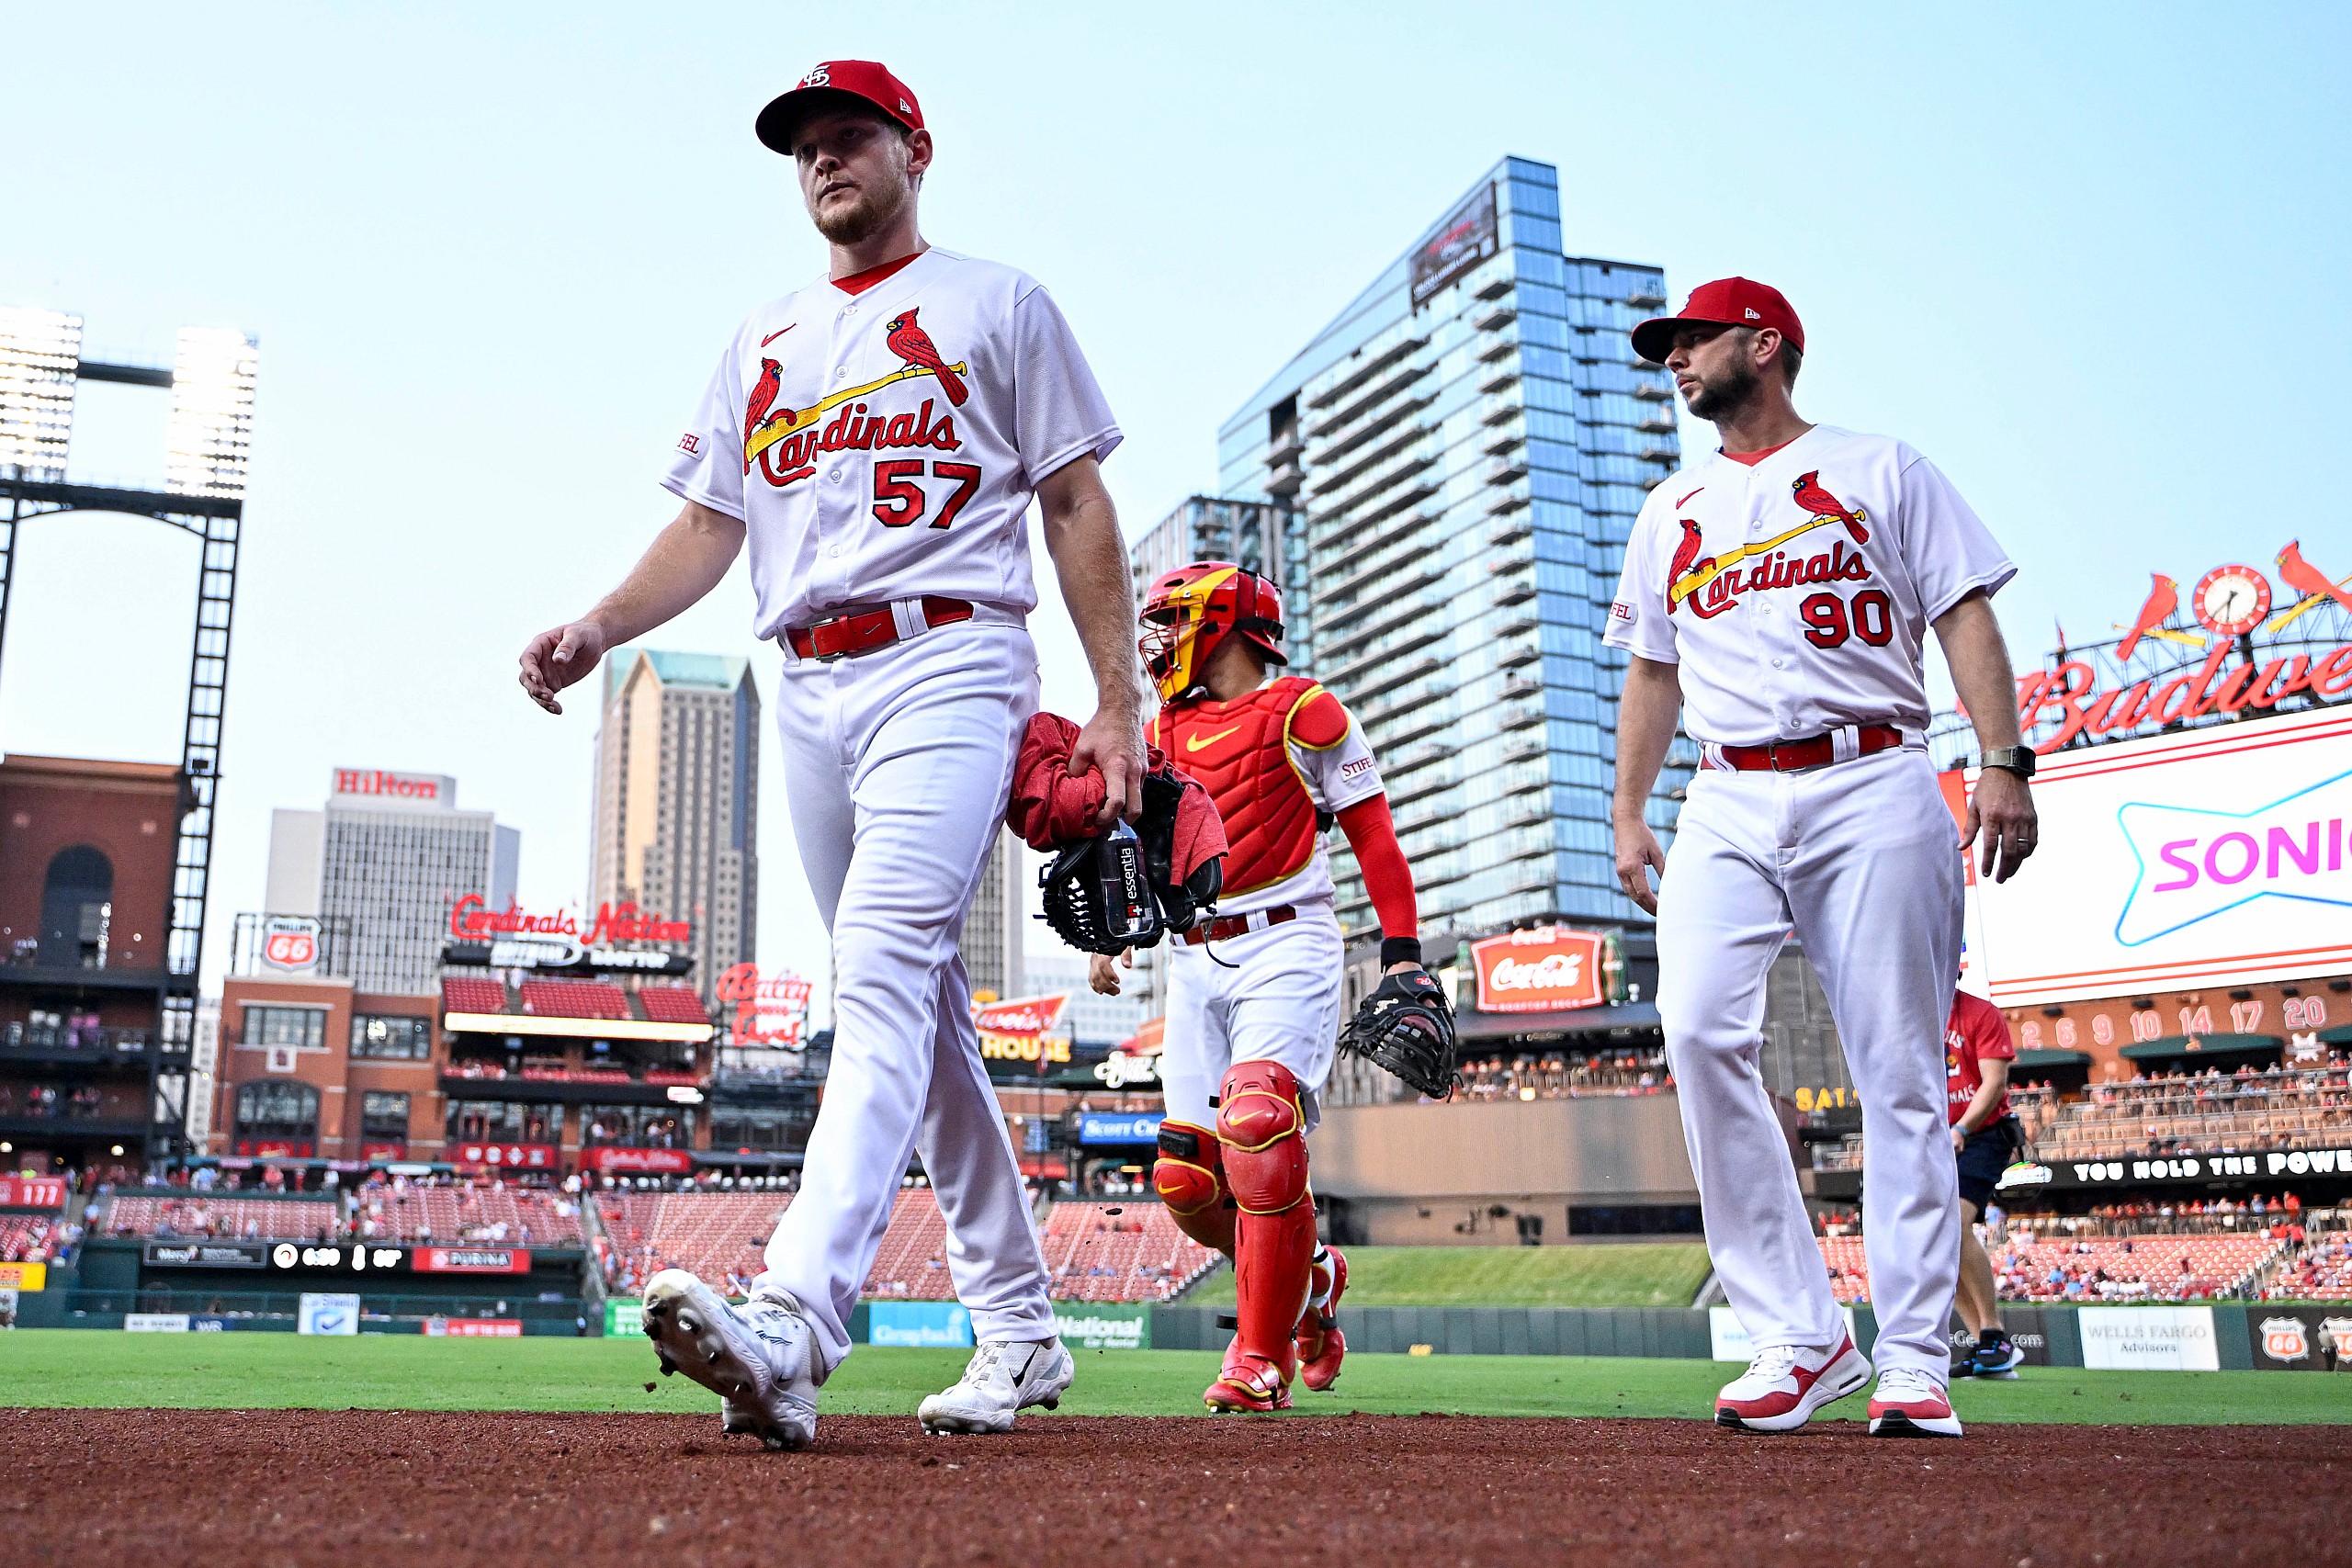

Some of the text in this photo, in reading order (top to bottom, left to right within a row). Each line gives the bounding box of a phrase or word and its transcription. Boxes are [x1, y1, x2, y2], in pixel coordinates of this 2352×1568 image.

[677, 433, 699, 455] FEL
[759, 398, 963, 488] Cardinals
[872, 458, 982, 530] 57
[1688, 539, 1871, 619] Cardinals
[1611, 602, 1632, 620] FEL
[1799, 589, 1894, 649] 90
[338, 770, 435, 799] Hilton
[2153, 818, 2352, 893] SONI
[1121, 847, 1137, 899] essentia
[451, 893, 689, 945] Cardinals Nation
[270, 937, 310, 961] 66
[2021, 996, 2327, 1051] 2 6 9 10 14 17 20
[1949, 1083, 1977, 1104] NALS
[2074, 1162, 2124, 1182] YOU
[2132, 1158, 2200, 1180] HOLD
[2208, 1156, 2257, 1176] THE
[449, 1251, 503, 1266] PURINA
[1057, 1315, 1145, 1338] National
[2086, 1325, 2207, 1339] WELLS FARGO
[2120, 1341, 2177, 1353] Advisors
[2271, 1335, 2298, 1353] 66
